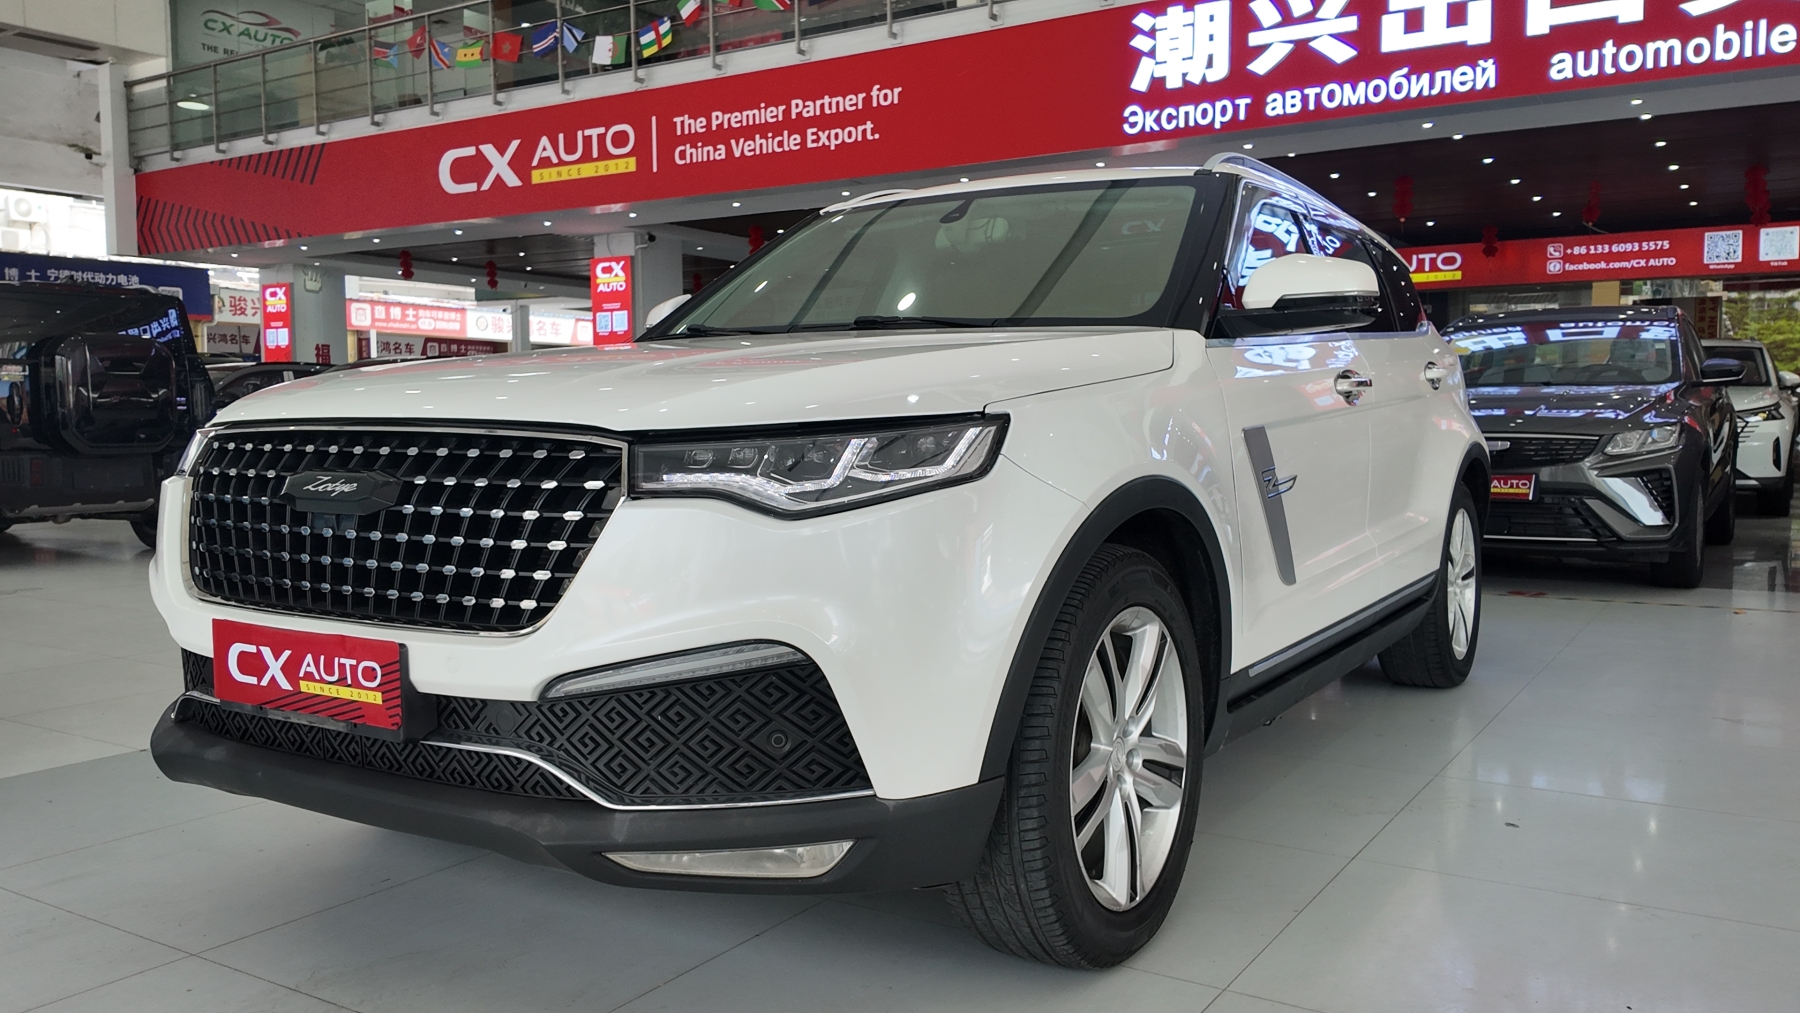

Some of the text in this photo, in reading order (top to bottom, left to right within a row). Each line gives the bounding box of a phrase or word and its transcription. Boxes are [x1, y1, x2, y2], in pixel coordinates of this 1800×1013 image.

[203, 18, 235, 35] CX
[201, 43, 219, 54] THE
[1549, 18, 1798, 81] automobile
[1122, 59, 1497, 135] Экспорт автомобилей
[673, 84, 902, 136] The Premier Partner for
[674, 120, 880, 165] China Vehicle Export.
[438, 123, 635, 194] CX AUTO
[538, 160, 630, 181] SINCE 2012
[1566, 240, 1670, 256] +86 133 6093 5575
[595, 260, 626, 278] CX
[1648, 257, 1676, 266] AUTO
[265, 286, 286, 301] CX
[597, 281, 626, 293] AUTO
[266, 304, 288, 313] AUTO
[1491, 480, 1530, 489] AUTO
[227, 642, 382, 690] CX AUTO
[305, 684, 378, 702] SINCE 2012
